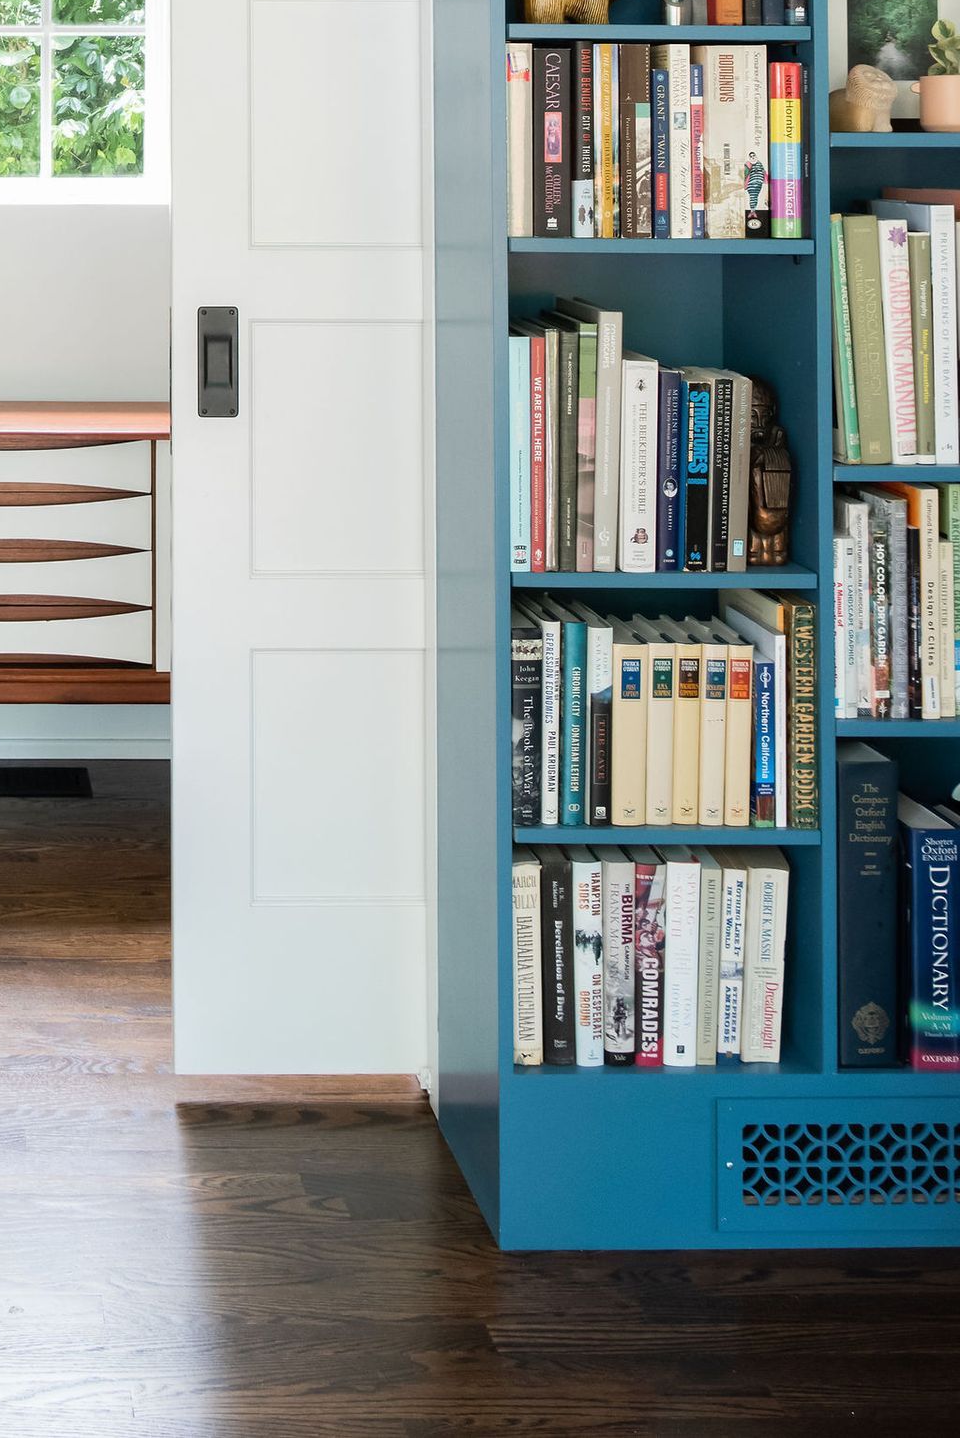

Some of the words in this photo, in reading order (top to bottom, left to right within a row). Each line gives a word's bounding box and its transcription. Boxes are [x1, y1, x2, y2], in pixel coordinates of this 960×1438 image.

[546, 53, 561, 109] CAESAR
[582, 115, 591, 130] CITY
[582, 133, 590, 142] OF
[784, 100, 794, 138] Hornby
[583, 146, 591, 172] THIEVES
[785, 181, 794, 216] Naked
[888, 268, 912, 357] GARDENING
[534, 377, 541, 390] WE
[896, 363, 915, 435] MANUAL
[640, 402, 648, 422] THE
[688, 391, 710, 474] STRUCTURES
[638, 425, 647, 486] BEEKEEPER'S
[638, 488, 647, 514] BIBLE
[876, 567, 885, 604] COLOR,
[877, 606, 885, 626] DRY
[928, 621, 934, 631] of
[795, 626, 814, 697] WESTERN
[877, 628, 886, 667] GARDEN
[523, 697, 533, 718] The
[761, 692, 770, 732] Northern
[524, 723, 534, 752] Book
[795, 703, 814, 763] GARDEN
[524, 755, 534, 768] of
[761, 736, 770, 778] California
[524, 771, 534, 795] War
[796, 769, 814, 808] BOOK
[579, 883, 588, 909] SIDES
[592, 872, 600, 916] HAMPTON
[622, 895, 632, 944] BURMA
[929, 865, 950, 1011] DICTIONARY
[555, 921, 564, 980] Dereliction
[555, 983, 564, 993] of
[555, 996, 565, 1021] Duty
[640, 958, 659, 1058] COMRADES!
[762, 982, 778, 1048] Dreadnought
